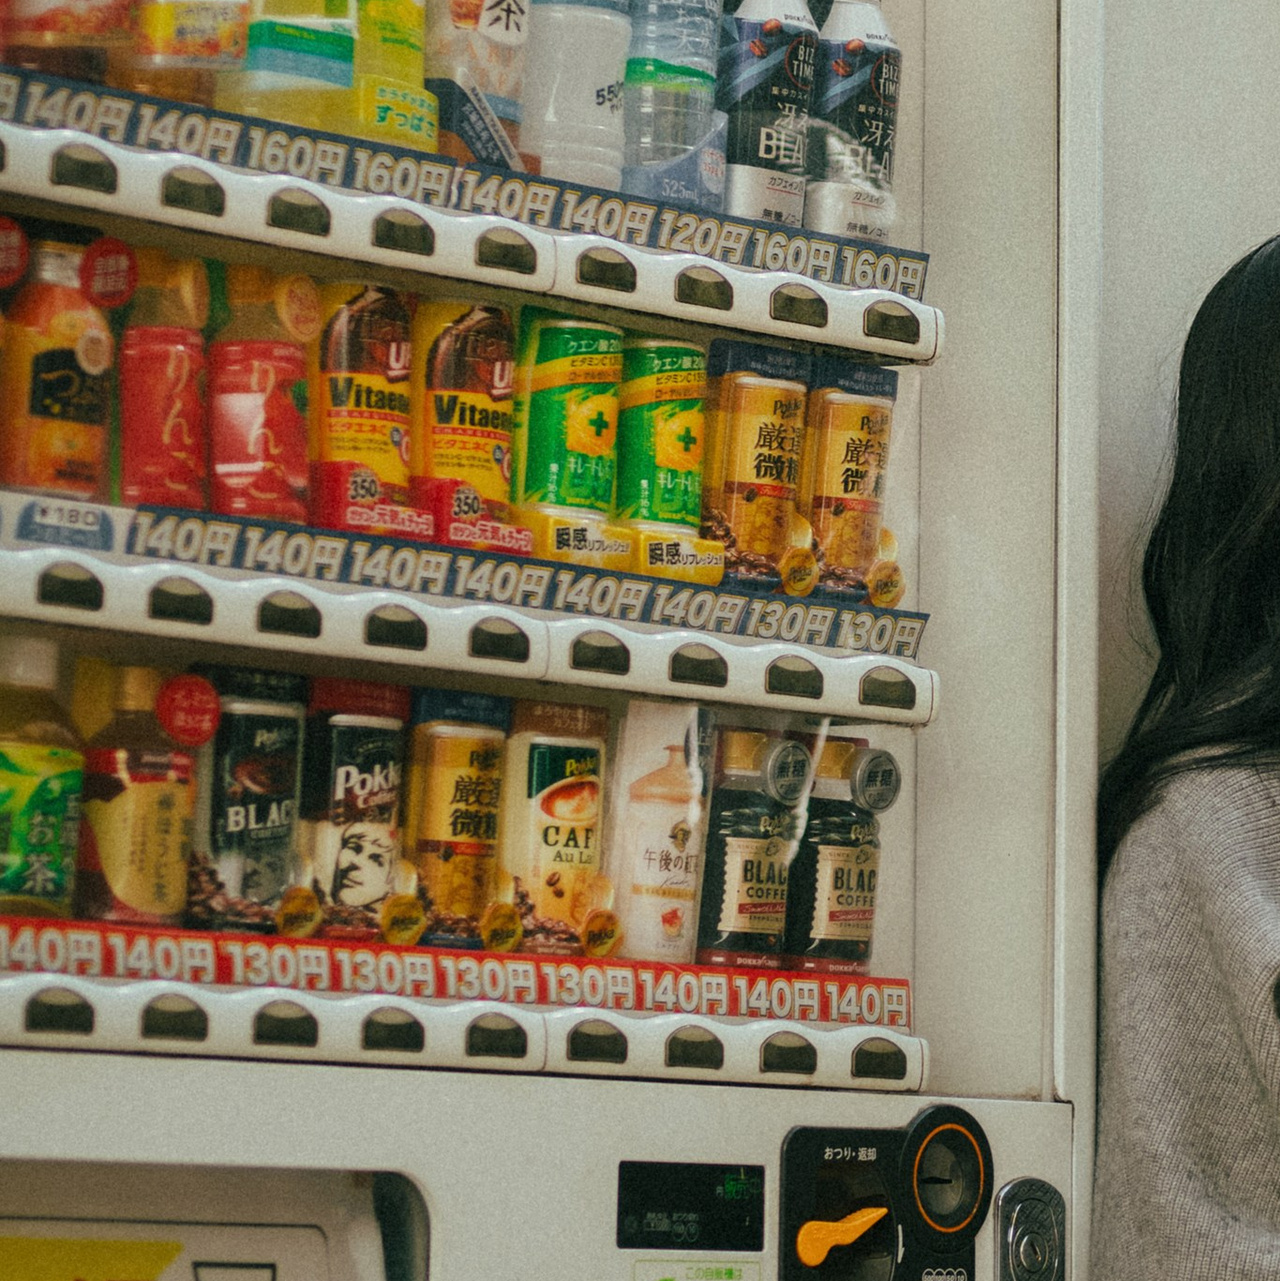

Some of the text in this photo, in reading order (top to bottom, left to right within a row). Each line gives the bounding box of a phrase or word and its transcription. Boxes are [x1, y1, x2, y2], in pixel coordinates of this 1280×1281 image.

[25, 82, 134, 144] 140円
[134, 101, 242, 165] 140円
[247, 123, 350, 187] 160円
[352, 147, 453, 209] 160円
[460, 167, 925, 301] 140円 140円 120円 160円 160円
[350, 478, 378, 500] 350
[452, 496, 481, 517] 350
[135, 513, 241, 567] 140円
[244, 528, 349, 581] 140円
[351, 542, 453, 595] 140円
[453, 556, 549, 608] 140円
[553, 572, 646, 622] 140円
[651, 584, 745, 634] 140円
[746, 597, 833, 649] 130円
[837, 608, 926, 659] 130円
[864, 768, 894, 789] 無糖
[553, 849, 575, 865] Au
[107, 936, 216, 985] 140円
[226, 940, 332, 992] 130円
[336, 947, 437, 1000] 130円
[440, 954, 536, 1006] 130円
[543, 964, 635, 1011] 130円
[643, 967, 729, 1016] 140円
[734, 975, 820, 1022] 140円
[826, 984, 908, 1027] 140円
[824, 1146, 877, 1162] おつり・返却
[685, 1267, 743, 1281] この自販機は
